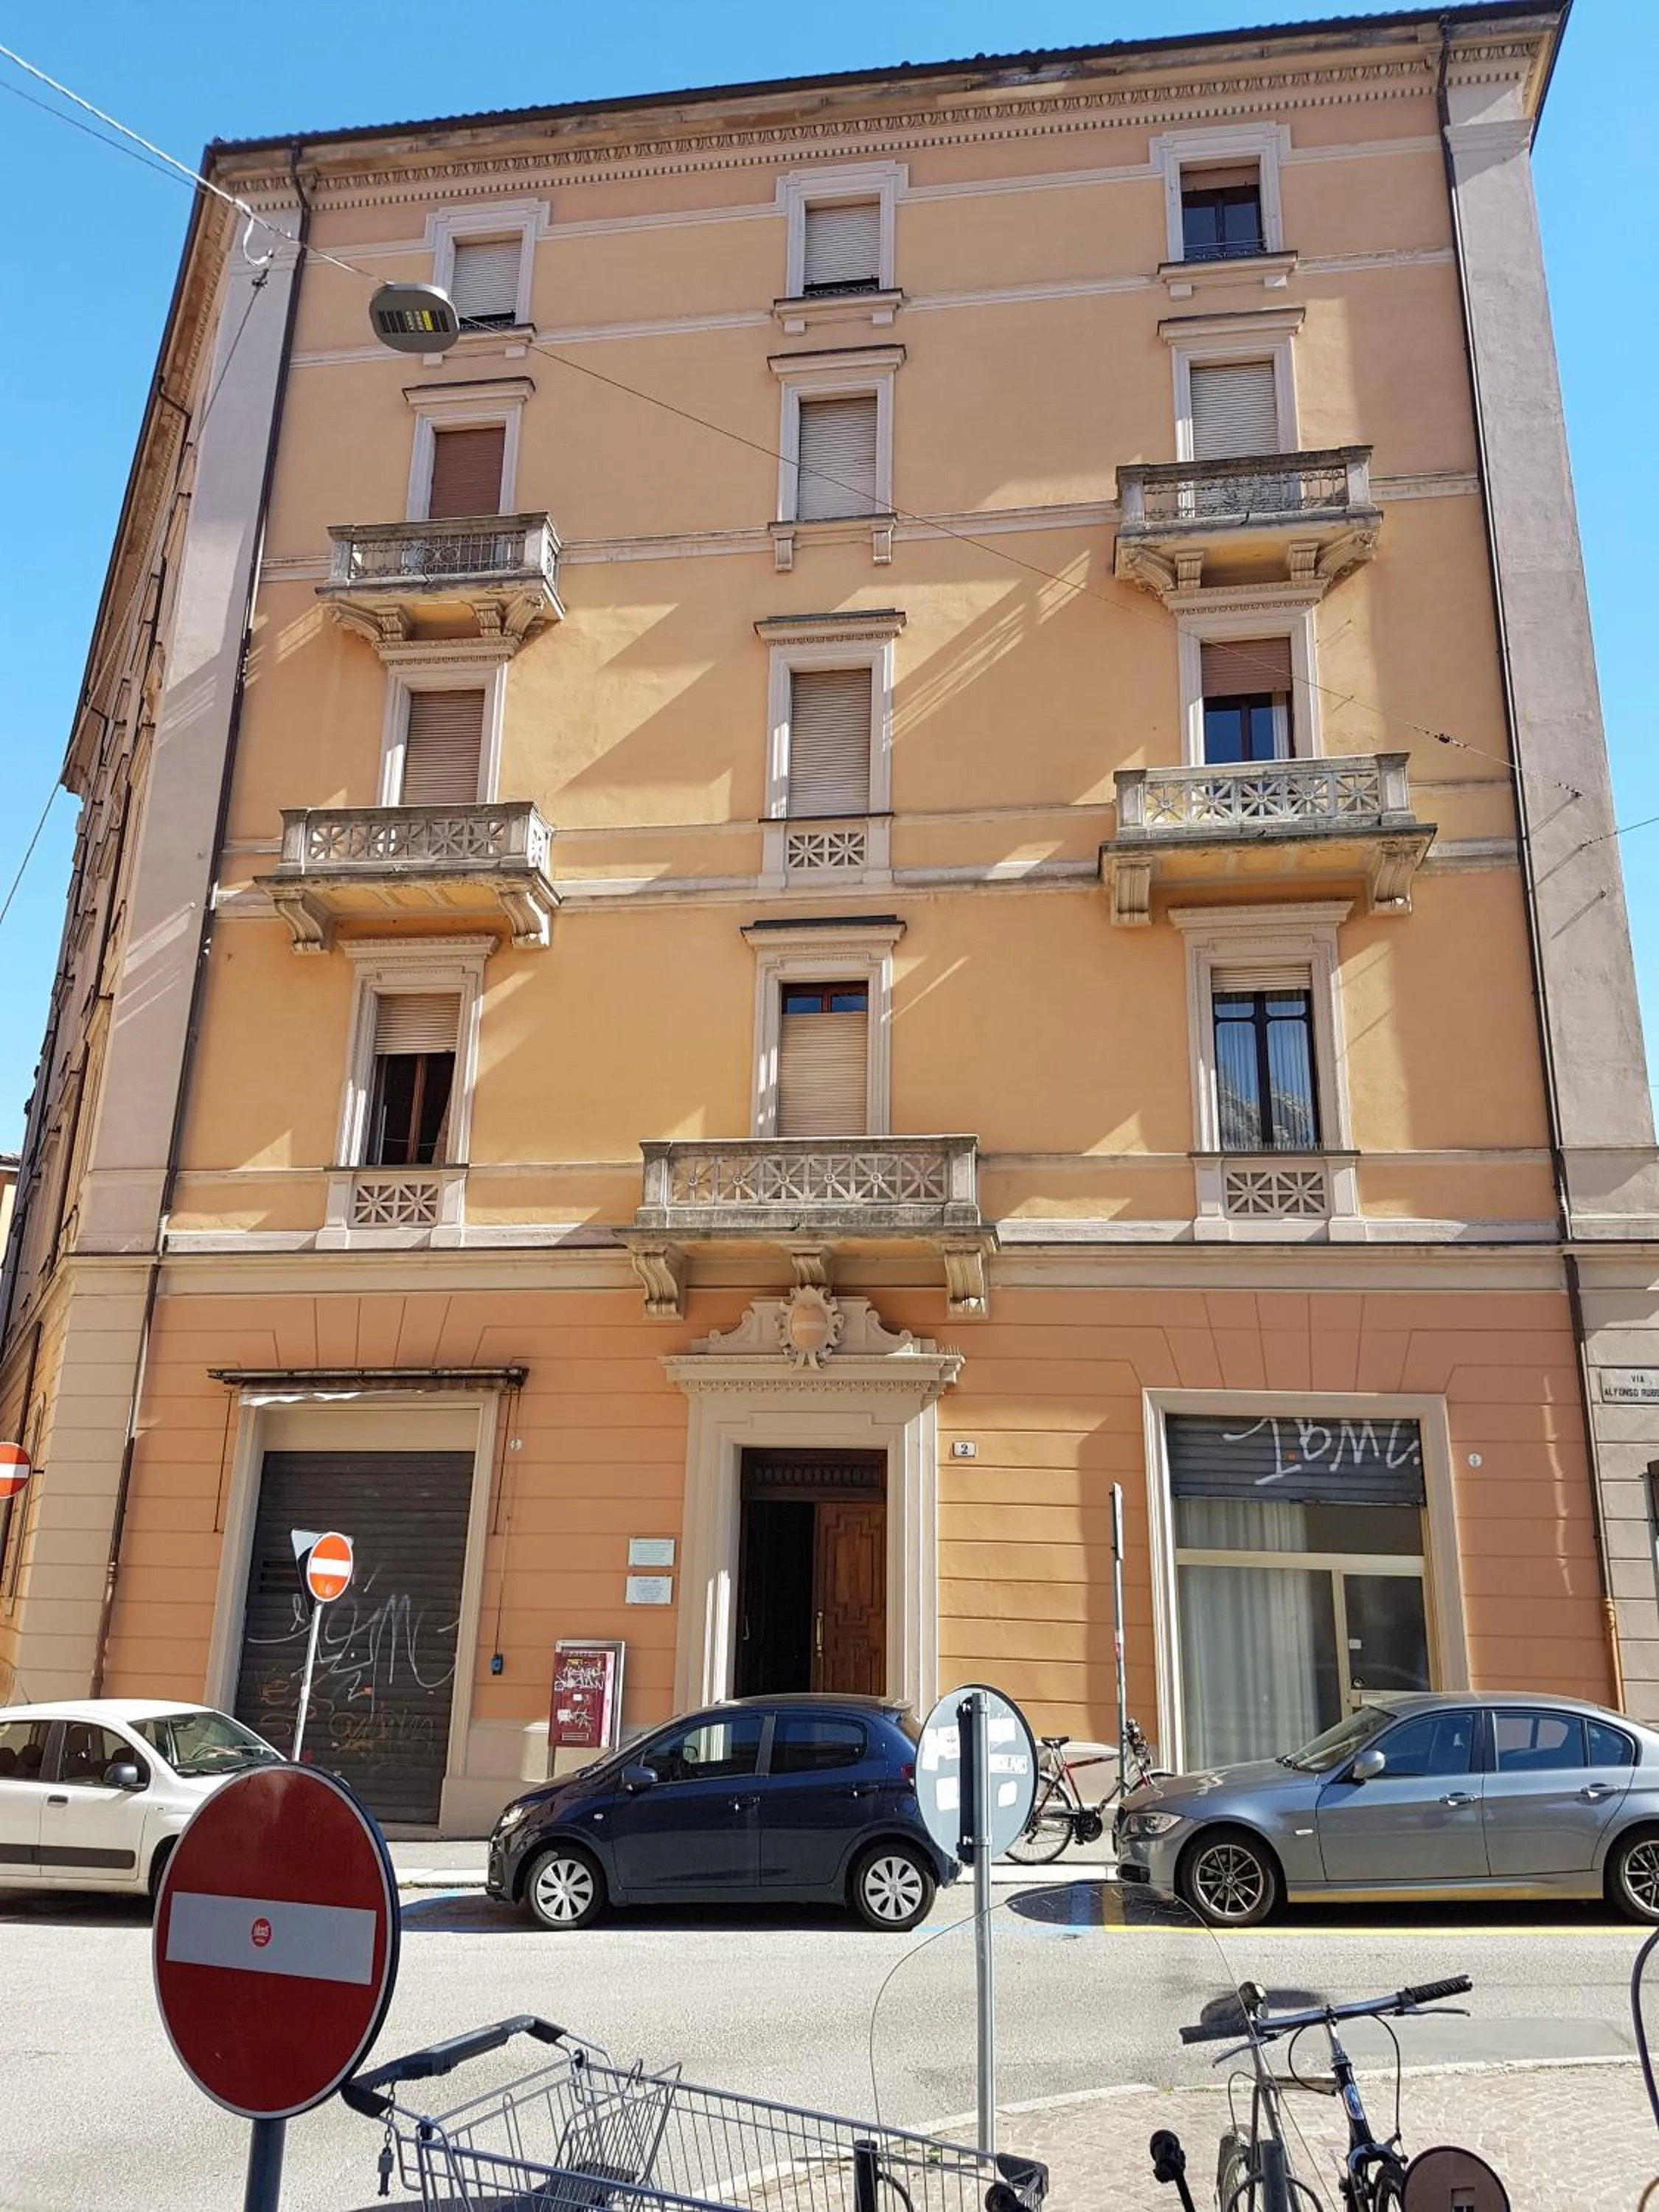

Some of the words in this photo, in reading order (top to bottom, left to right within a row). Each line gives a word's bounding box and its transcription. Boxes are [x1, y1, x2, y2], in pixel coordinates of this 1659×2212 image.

[1630, 1374, 1645, 1382] VIA
[1604, 1387, 1639, 1397] ALFONSO
[961, 1443, 968, 1455] 2
